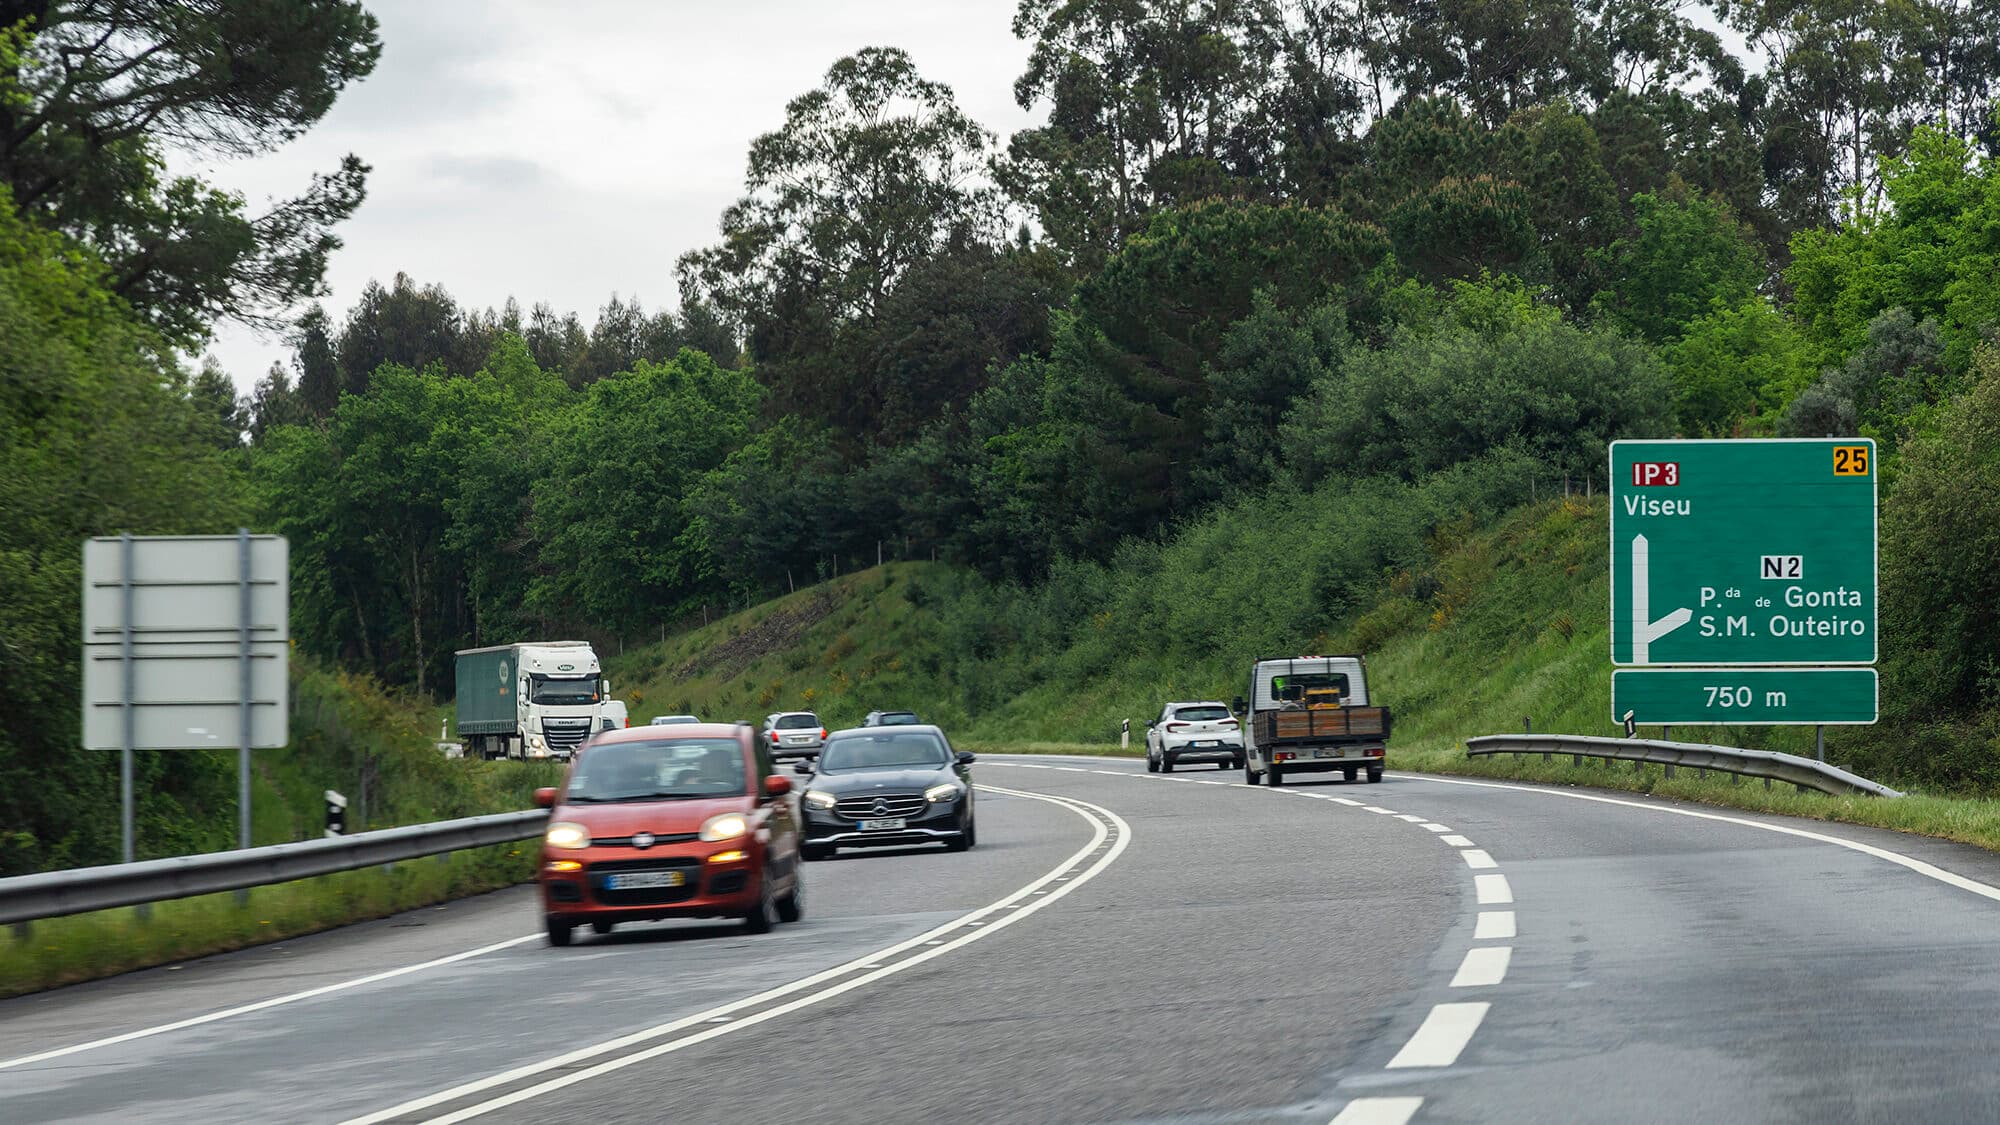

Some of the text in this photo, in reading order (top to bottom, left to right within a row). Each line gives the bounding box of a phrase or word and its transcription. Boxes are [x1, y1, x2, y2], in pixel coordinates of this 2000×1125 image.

[1835, 449, 1867, 473] 25
[1623, 495, 1691, 516] Viseu
[1764, 557, 1800, 578] N2
[1755, 597, 1771, 608] de
[1784, 586, 1862, 608] Gonta
[1699, 615, 1865, 637] S.M. Outeiro
[1703, 686, 1787, 708] 750 m
